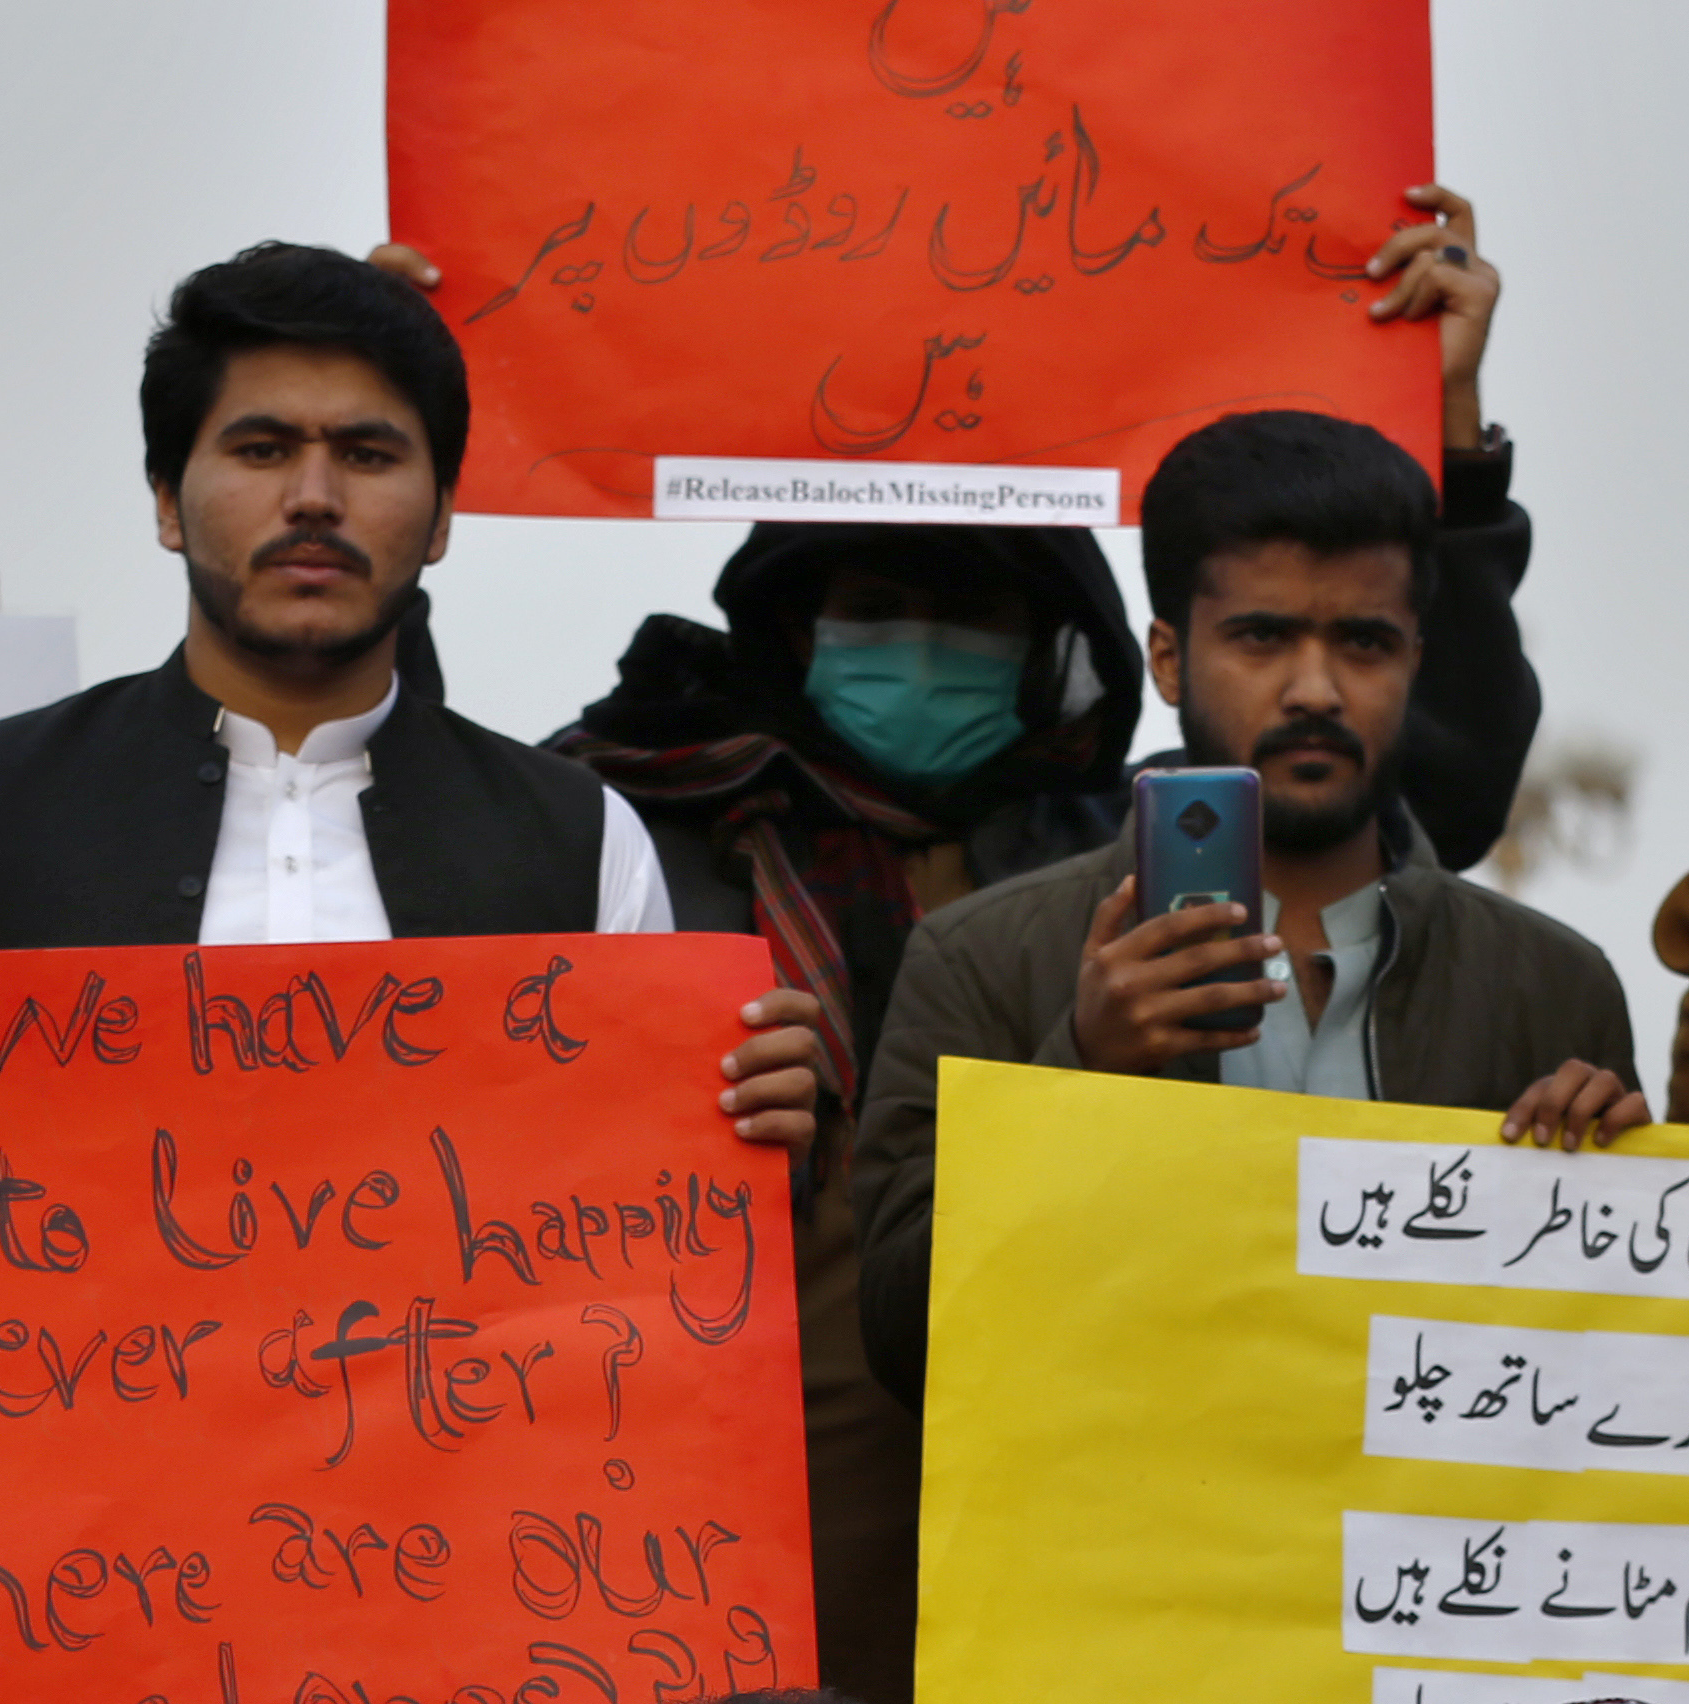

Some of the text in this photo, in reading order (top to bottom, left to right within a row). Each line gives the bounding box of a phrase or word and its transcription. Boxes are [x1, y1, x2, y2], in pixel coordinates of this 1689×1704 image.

[666, 477, 1106, 511] #ReleaseBalochMissingPersons
[183, 950, 447, 1075] have
[504, 954, 588, 1064] a
[430, 1125, 753, 1344] happily
[1319, 1182, 1394, 1249] ہیں
[1401, 1149, 1487, 1241] نکلے
[1503, 1176, 1618, 1269] خاطر
[1384, 1331, 1452, 1424] چلو
[1459, 1356, 1579, 1426] ساتھ
[248, 1502, 452, 1602] are
[510, 1510, 741, 1620] our
[1354, 1557, 1431, 1627] ہیں
[1437, 1525, 1520, 1617] نکلے
[1540, 1549, 1677, 1621] مٹانے
